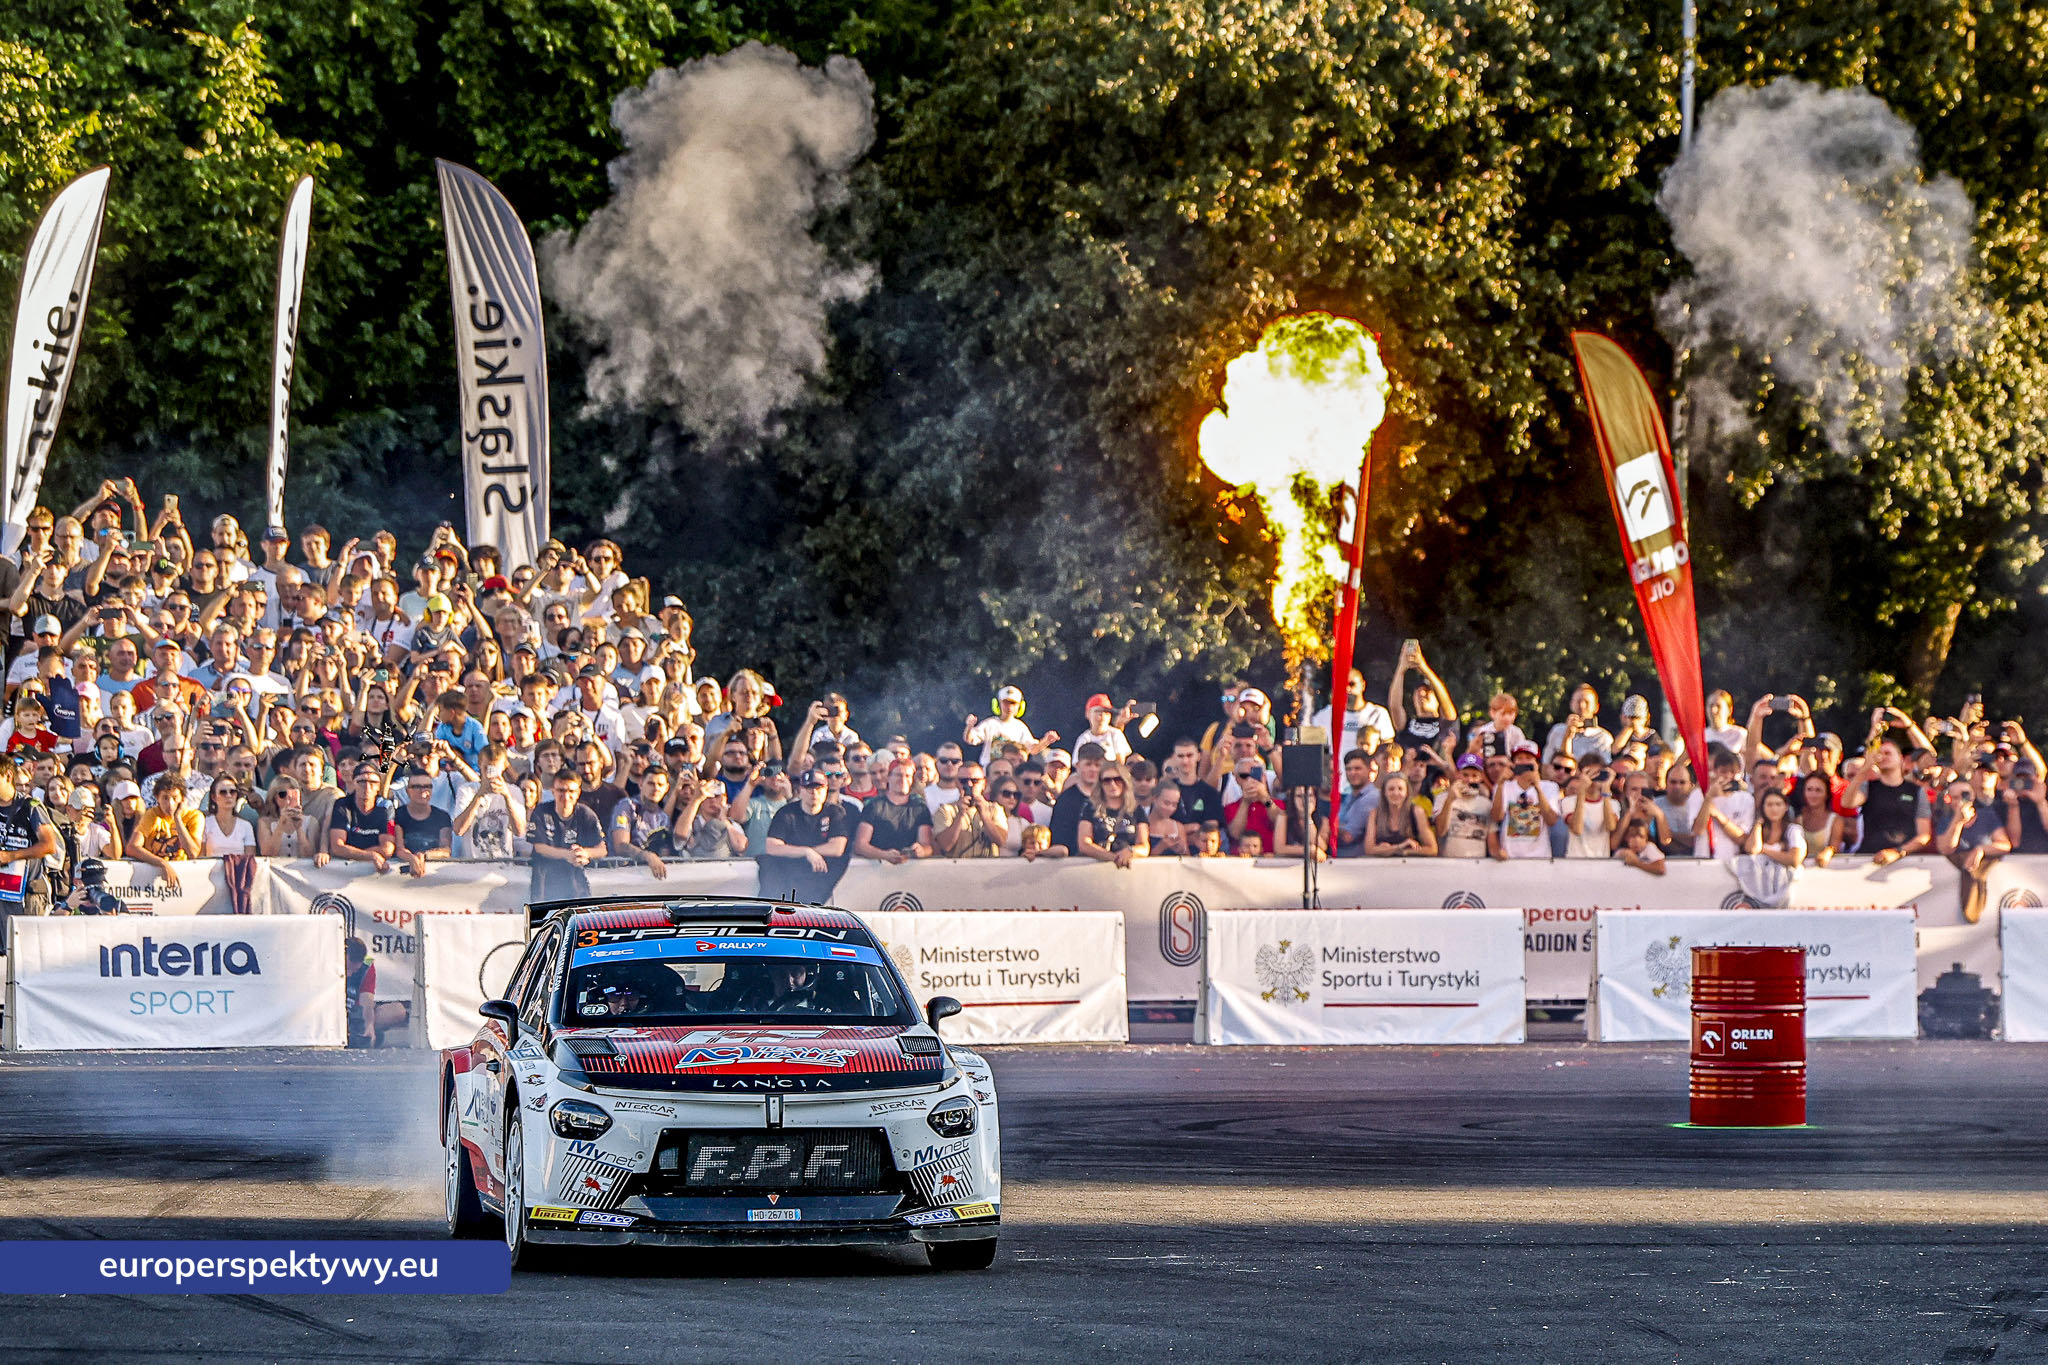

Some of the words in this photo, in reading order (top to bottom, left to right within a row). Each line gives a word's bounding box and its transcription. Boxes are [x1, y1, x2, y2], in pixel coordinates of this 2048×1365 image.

[108, 886, 141, 898] ADION
[578, 930, 599, 947] 3
[599, 927, 847, 941] YPSILON
[1525, 933, 1577, 952] ADION
[100, 936, 261, 978] interia
[921, 946, 1039, 964] Ministerstwo
[1322, 947, 1441, 964] Ministerstwo
[920, 971, 981, 990] Sportu
[988, 970, 992, 986] i
[1000, 967, 1080, 989] Turystyki
[1322, 970, 1382, 990] Sportu
[1388, 970, 1392, 986] i
[1400, 970, 1480, 991] Turystyki
[130, 990, 235, 1015] SPORT
[1731, 1029, 1773, 1040] ORLEN
[1731, 1041, 1748, 1050] OIL
[713, 1078, 832, 1088] LANCIA
[615, 1101, 676, 1114] INTERCAR
[871, 1099, 927, 1112] INTERCAR
[568, 1140, 638, 1168] Mynet
[914, 1138, 970, 1166] Mynet
[690, 1145, 855, 1180] F.P.F.
[535, 1208, 573, 1219] PIRELLI
[754, 1211, 765, 1220] HD
[768, 1211, 782, 1220] 267
[784, 1211, 794, 1220] YB
[908, 1210, 951, 1222] sparco
[959, 1203, 993, 1216] PIRELLI
[583, 1212, 634, 1224] sparco
